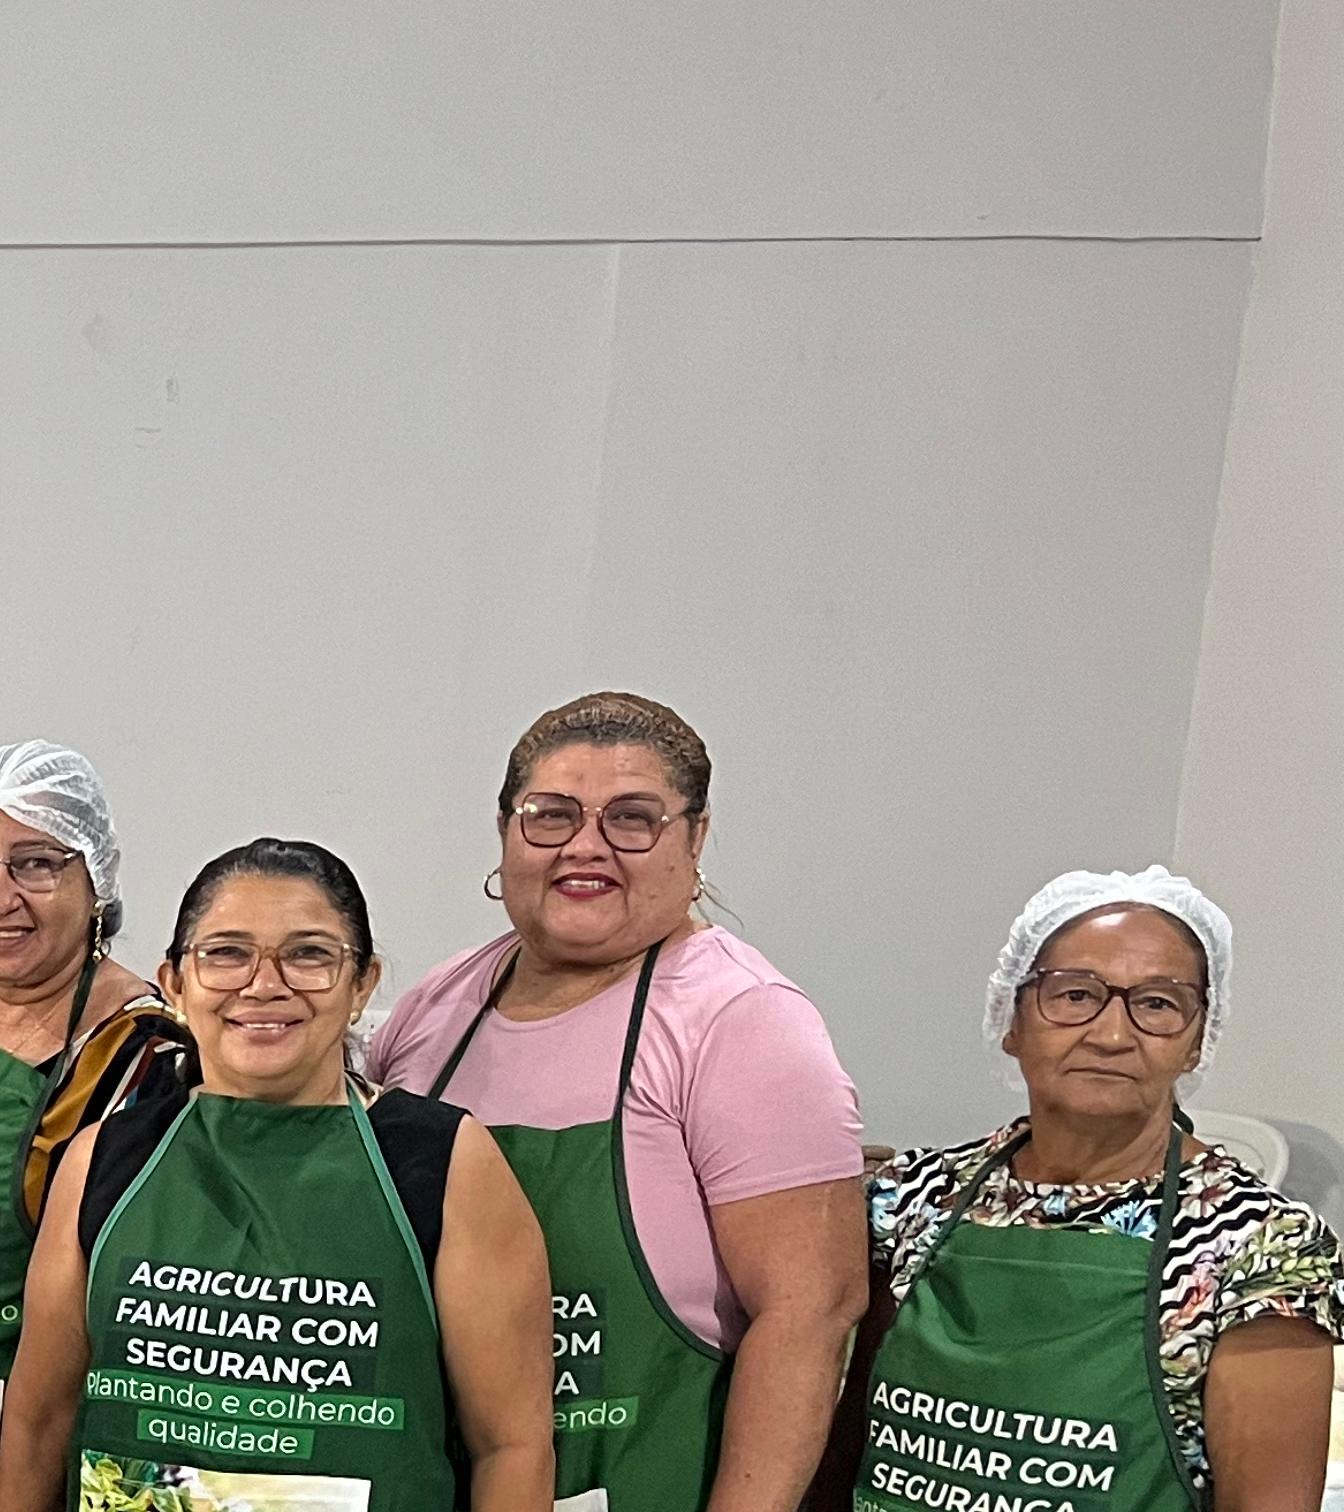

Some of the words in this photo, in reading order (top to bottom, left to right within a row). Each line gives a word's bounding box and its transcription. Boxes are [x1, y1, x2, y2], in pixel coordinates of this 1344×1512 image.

[128, 1260, 377, 1309] AGRICULTURA
[114, 1297, 283, 1343] FAMILIAR
[290, 1318, 380, 1349] COM
[125, 1336, 353, 1393] SEGURANÇA
[86, 1371, 213, 1412] Plantando
[221, 1394, 241, 1415] e
[248, 1393, 396, 1427] colhendo
[872, 1381, 1119, 1453] AGRICULTURA
[147, 1417, 299, 1455] qualidade
[869, 1419, 1013, 1481] FAMILIAR
[1018, 1457, 1115, 1493] COM
